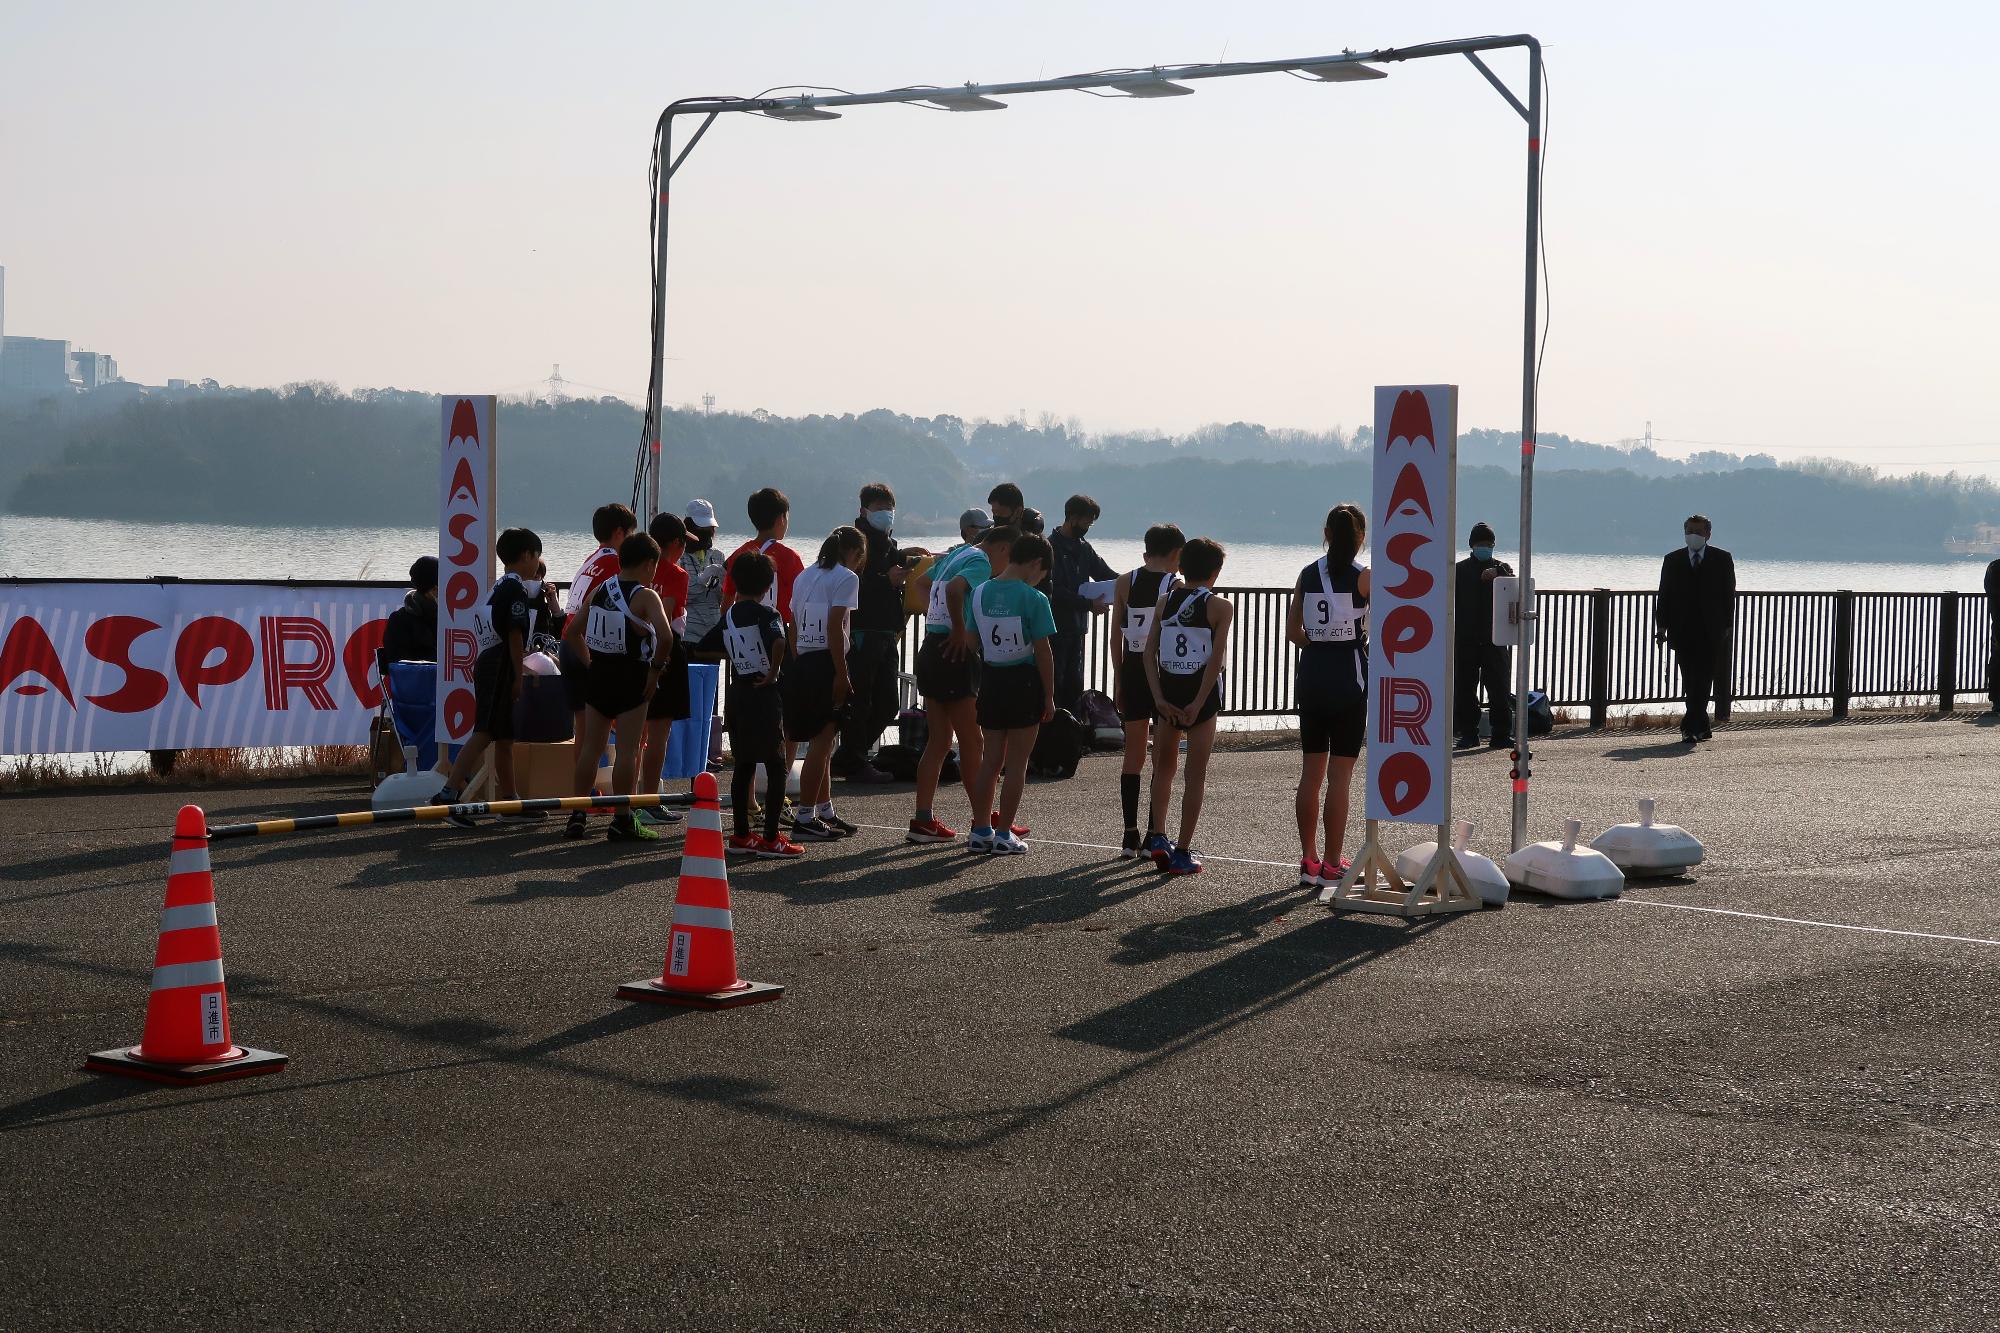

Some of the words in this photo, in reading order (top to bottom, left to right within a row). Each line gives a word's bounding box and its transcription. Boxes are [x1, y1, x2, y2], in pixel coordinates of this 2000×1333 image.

[444, 397, 480, 740] MASPRO
[1132, 614, 1146, 628] 7
[1378, 389, 1436, 817] MASPRO
[593, 612, 622, 641] 11-1
[991, 623, 1018, 647] 6-1
[208, 996, 220, 1041] 日進市
